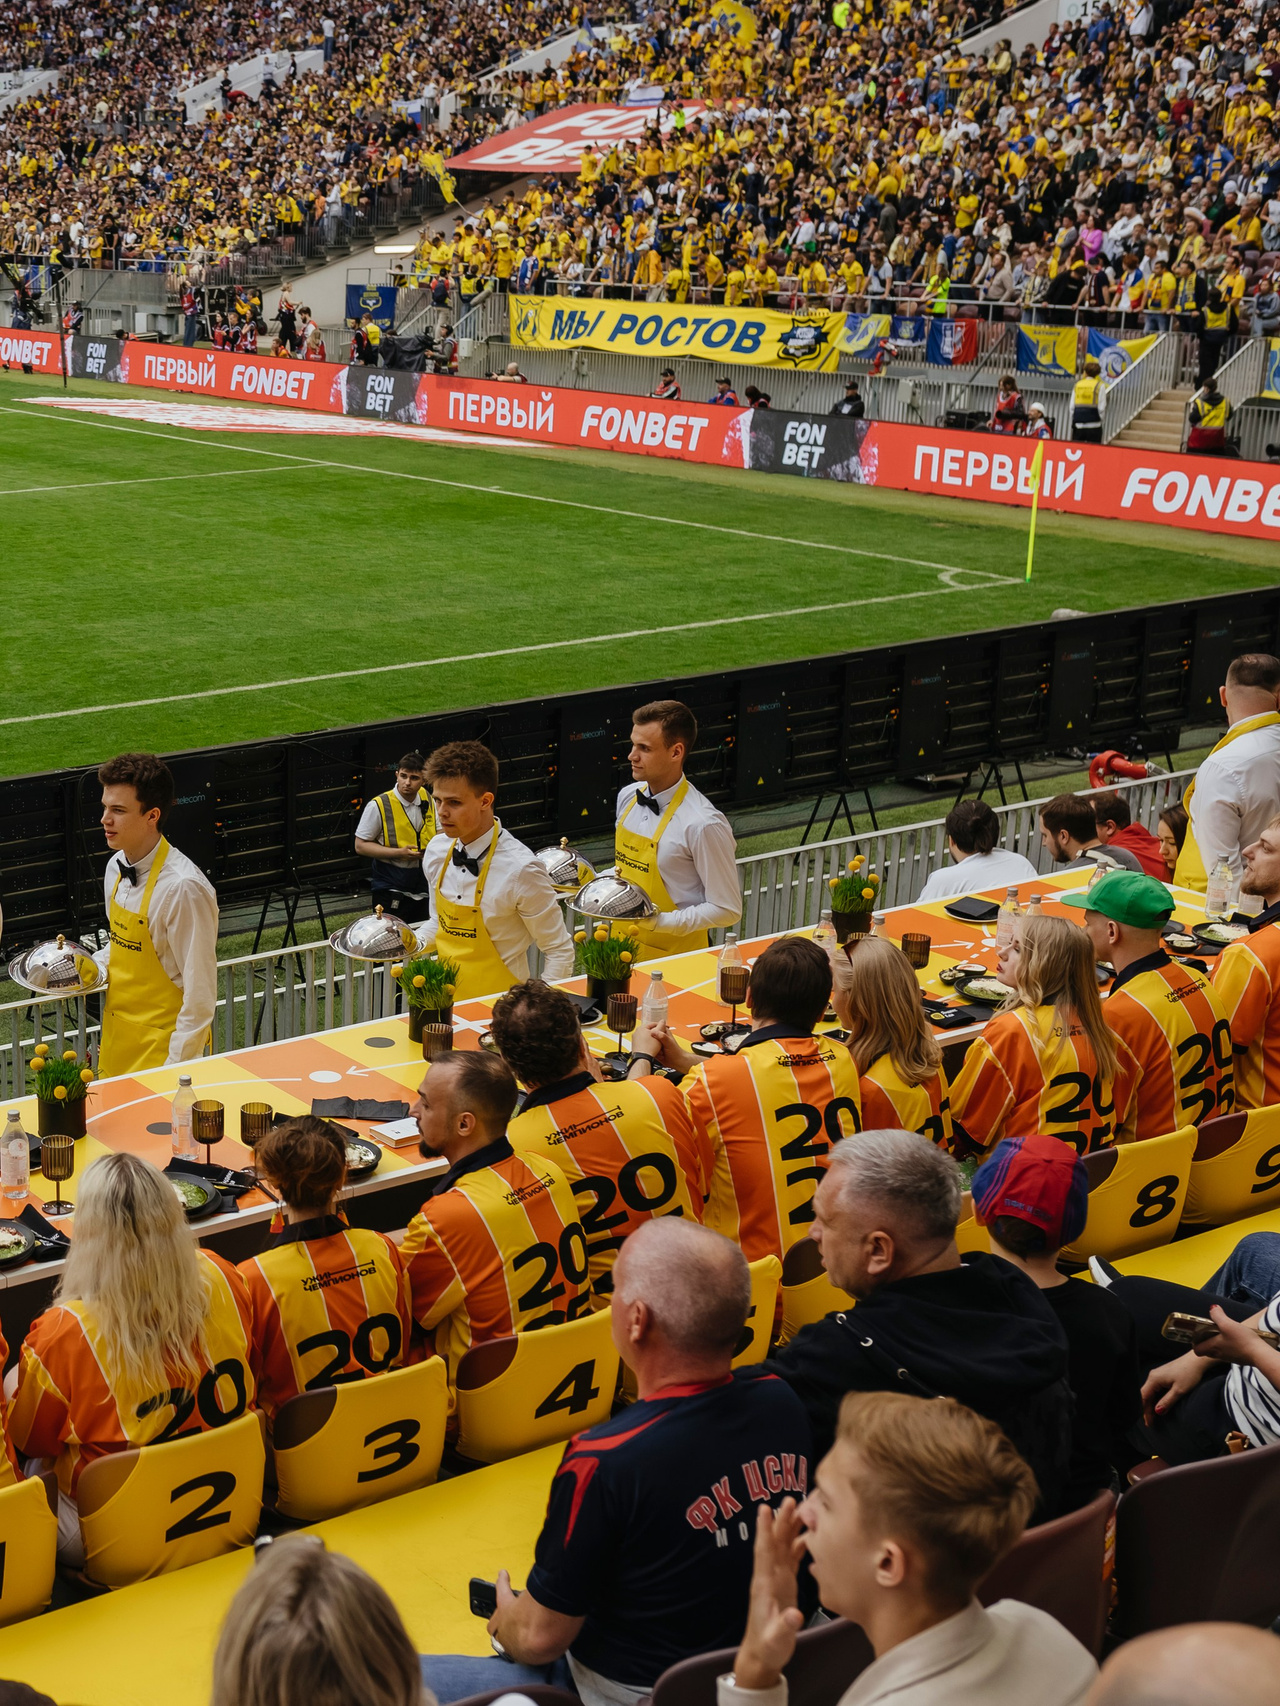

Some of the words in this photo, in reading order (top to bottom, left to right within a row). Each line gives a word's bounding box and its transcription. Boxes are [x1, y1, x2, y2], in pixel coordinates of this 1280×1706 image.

[1081, 0, 1100, 17] 15
[533, 106, 701, 138] FON
[86, 342, 107, 358] FON
[550, 310, 605, 341] МЫ
[607, 313, 767, 355] РОСТОВ
[85, 358, 106, 375] BET
[144, 354, 216, 388] ПЕРВЫЙ
[230, 364, 315, 401] FONBET
[366, 374, 394, 394] FON
[365, 393, 394, 413] BET
[448, 391, 555, 433] ПЕРВЫЙ
[580, 405, 710, 451] FONBET
[781, 444, 825, 470] BET
[783, 421, 827, 446] FON
[1120, 467, 1280, 528] FONBE
[778, 1054, 837, 1067] ЧЕМПИОНОВ
[1176, 1018, 1233, 1089] 20
[548, 1111, 624, 1146] ЧЕМПИОНОВ
[775, 1097, 862, 1161] 20
[507, 1178, 556, 1206] ЧЕМПИОНОВ
[570, 1152, 678, 1235] 20
[1129, 1175, 1180, 1228] 8
[303, 1267, 377, 1293] ЧЕМПИОНОВ
[512, 1221, 589, 1312] 20
[297, 1313, 402, 1391] 20
[135, 1358, 247, 1446] 20
[534, 1358, 600, 1420] 4
[357, 1419, 421, 1484] 3
[165, 1471, 237, 1544] 2
[685, 1475, 743, 1534] ФК
